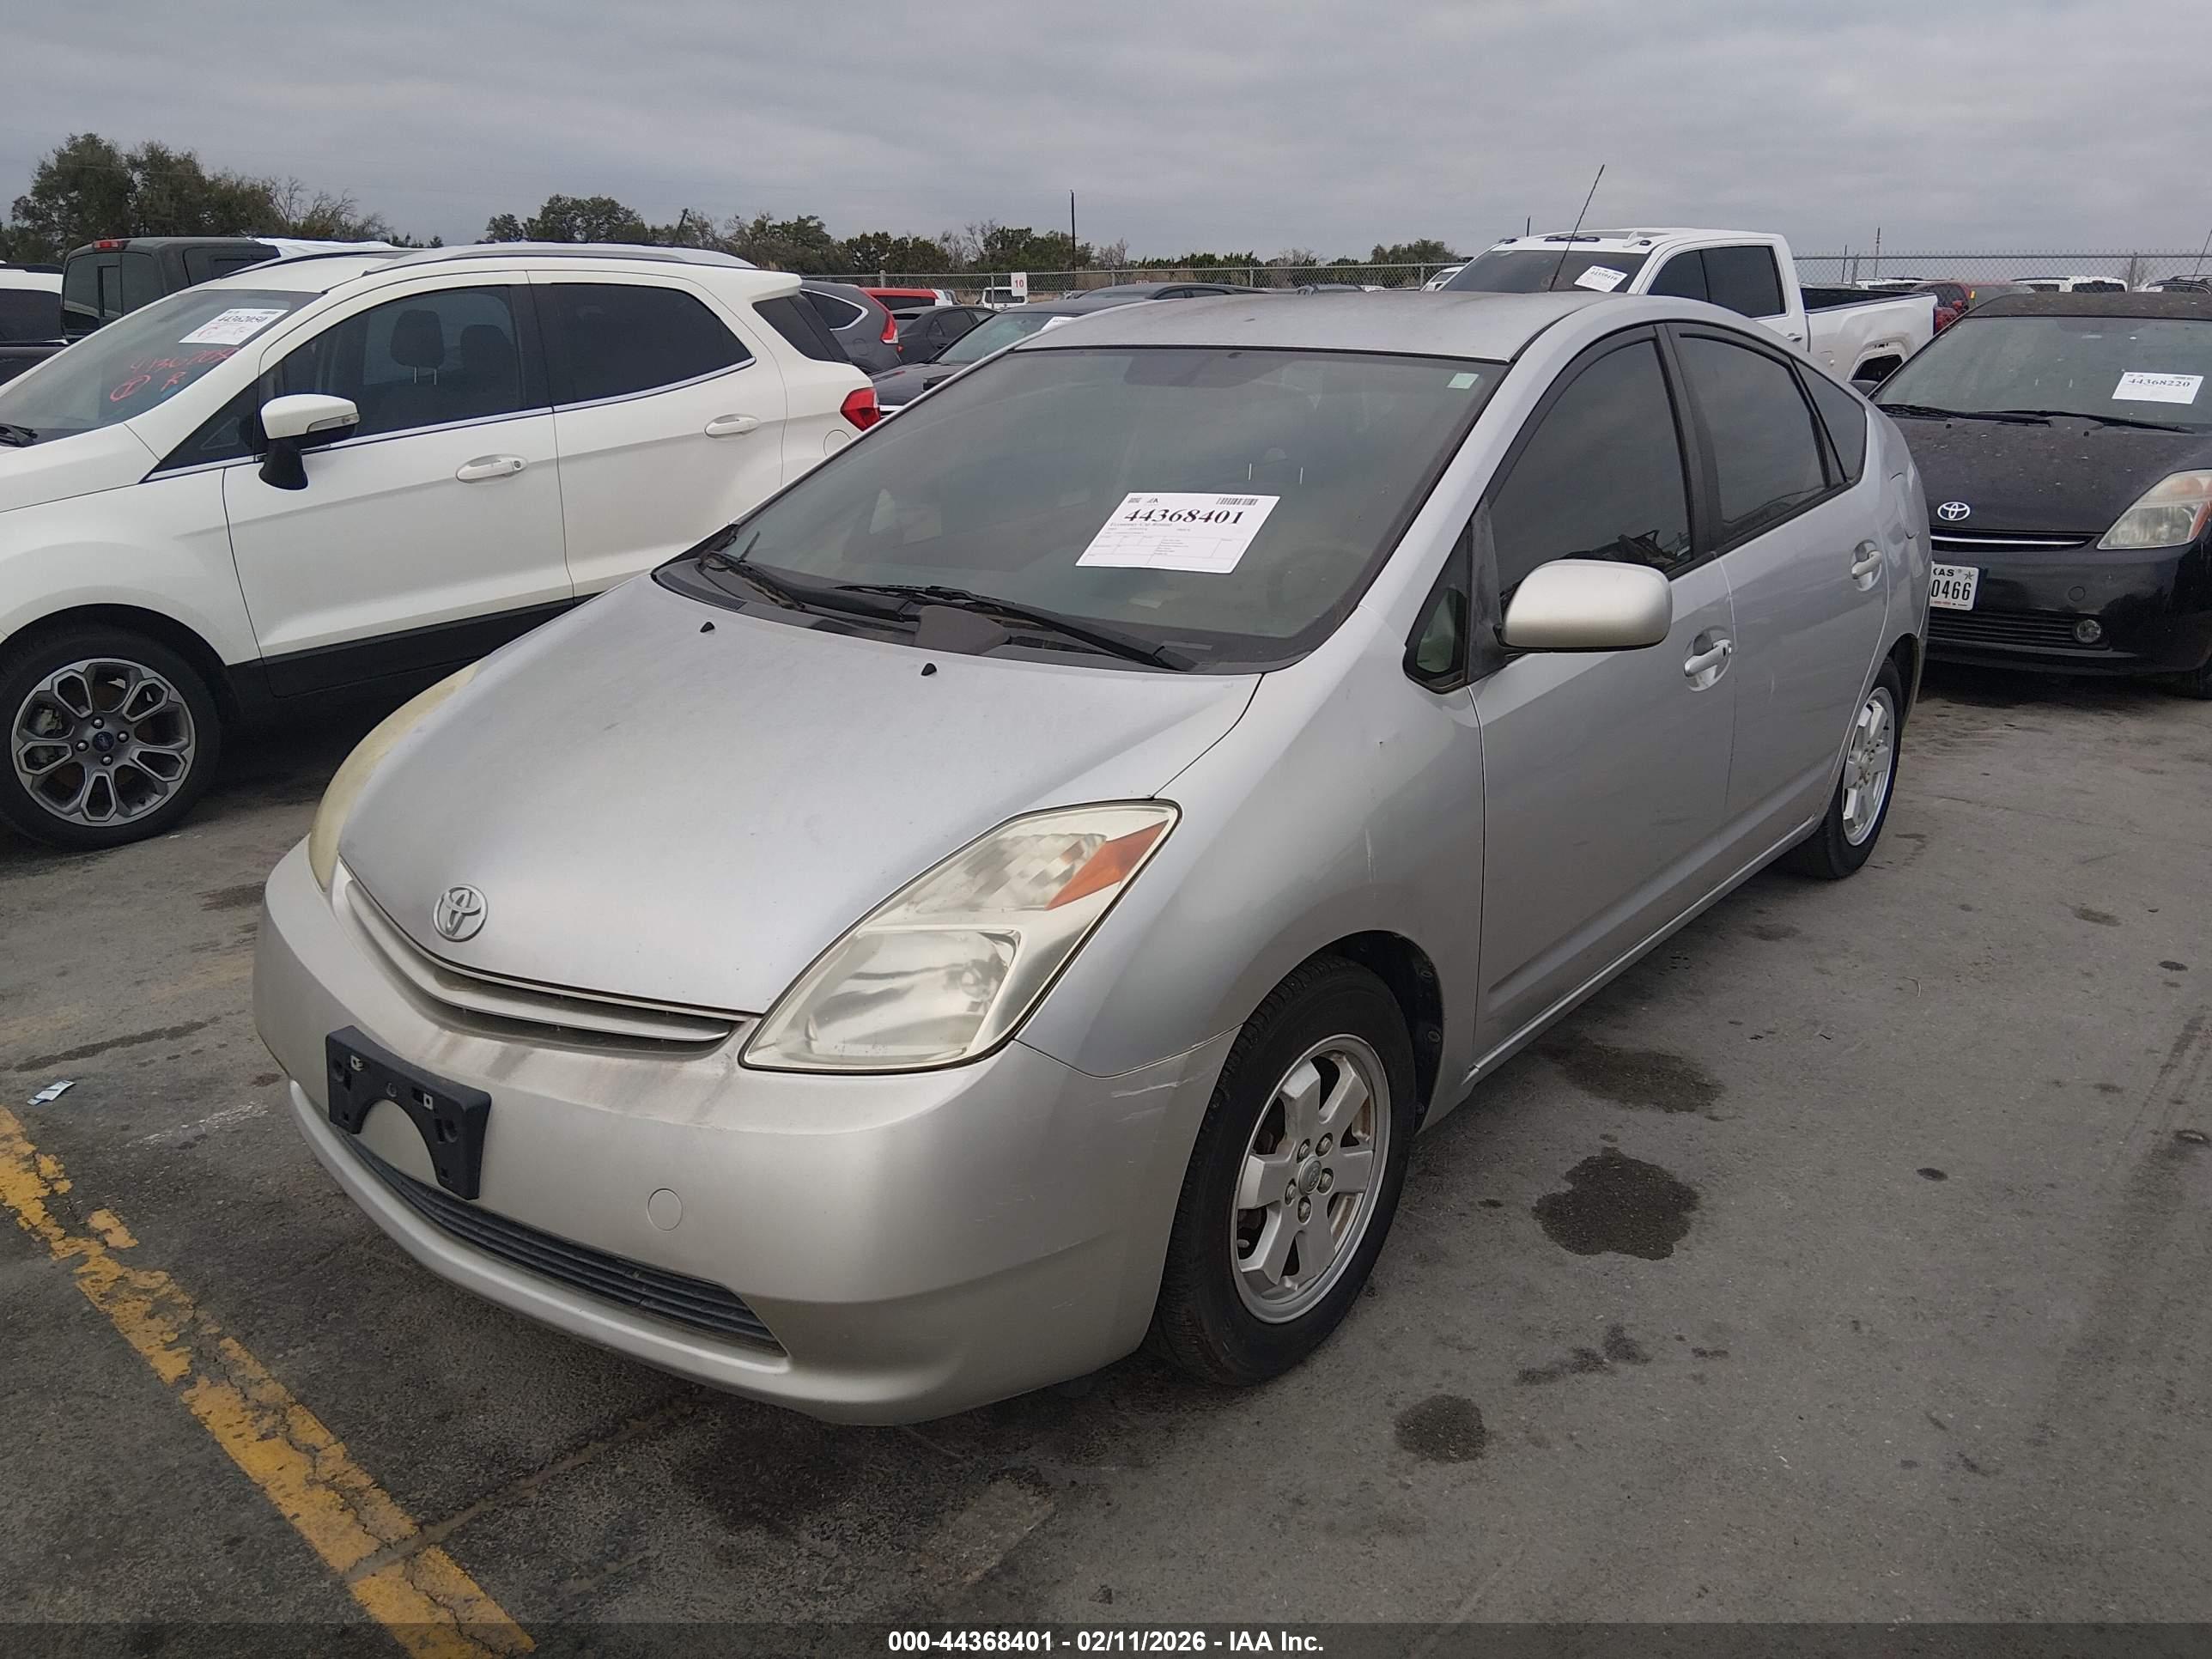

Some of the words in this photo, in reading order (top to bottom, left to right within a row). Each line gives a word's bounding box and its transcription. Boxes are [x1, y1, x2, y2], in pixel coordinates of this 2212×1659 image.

[1014, 279, 1024, 289] 10
[2128, 378, 2191, 387] 44368220
[1124, 508, 1244, 525] 44368401
[1930, 579, 1972, 601] 0466
